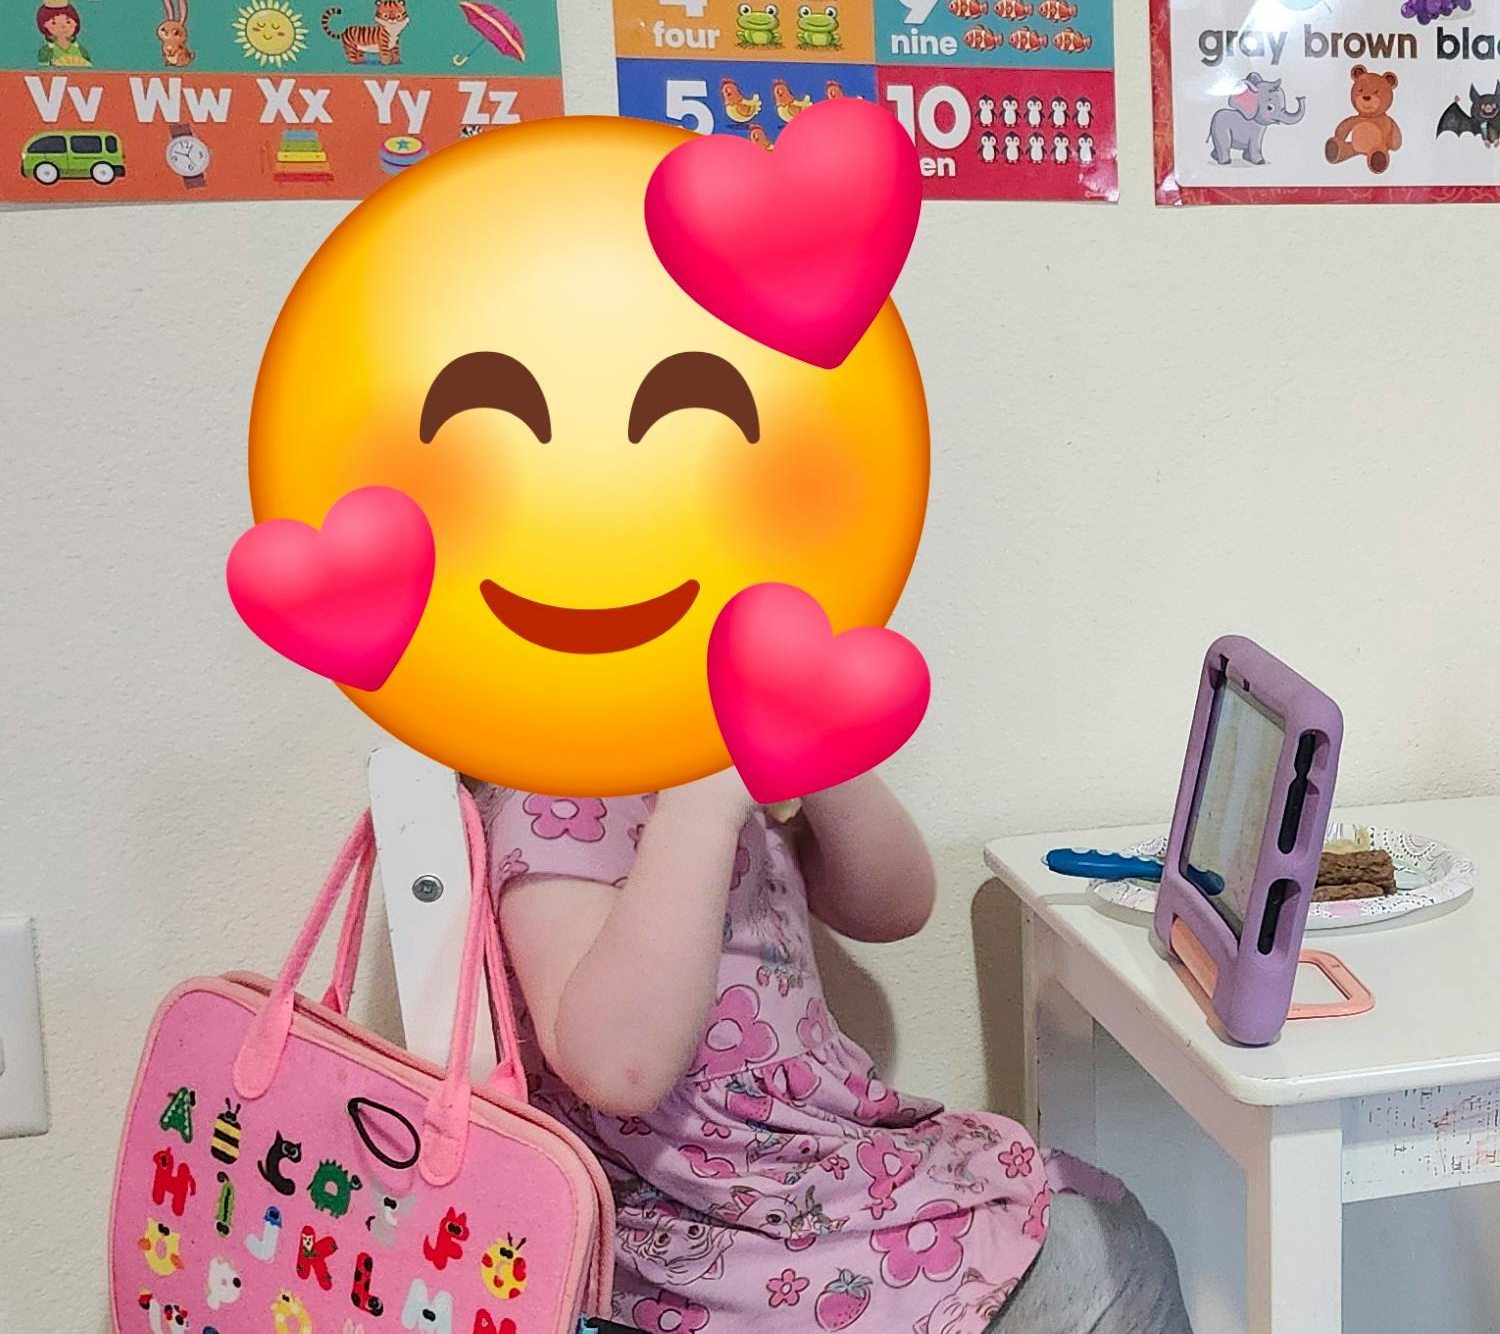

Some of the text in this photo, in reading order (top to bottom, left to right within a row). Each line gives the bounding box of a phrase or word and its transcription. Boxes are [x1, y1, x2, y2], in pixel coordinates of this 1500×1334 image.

[653, 20, 720, 49] four
[891, 27, 958, 56] nine
[1198, 27, 1288, 66] gray
[1303, 24, 1418, 60] brown
[24, 76, 521, 134] Vv Ww Xx Yy Zz
[666, 80, 714, 135] 5
[887, 85, 971, 149] 10
[920, 157, 956, 177] en
